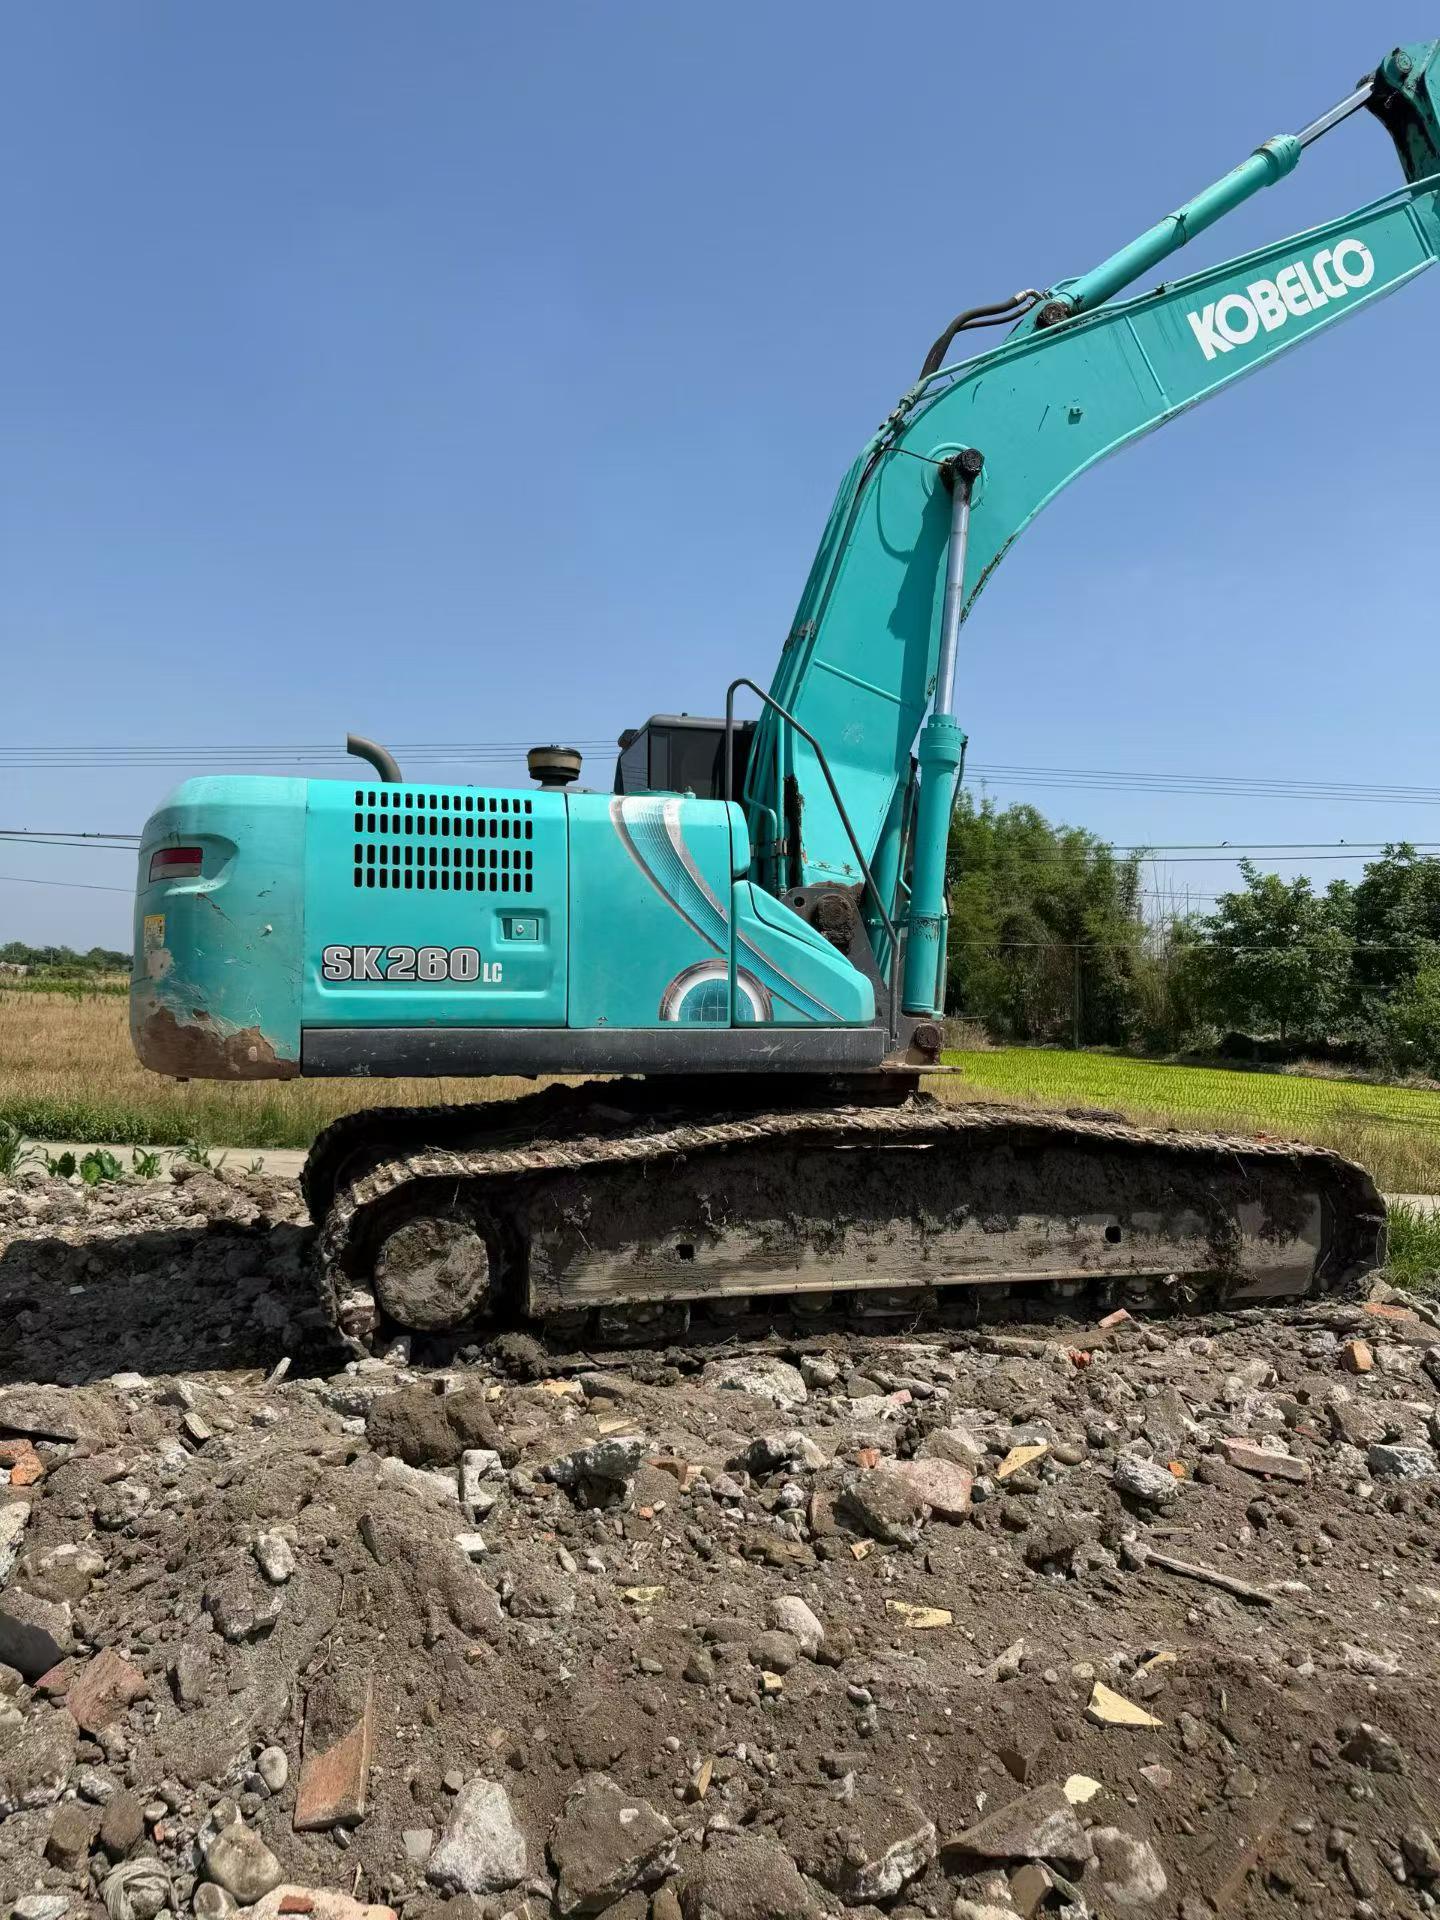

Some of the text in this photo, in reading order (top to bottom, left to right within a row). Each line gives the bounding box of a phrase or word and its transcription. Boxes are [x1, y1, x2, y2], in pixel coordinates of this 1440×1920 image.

[1186, 239, 1375, 361] KOBELCO
[322, 944, 502, 983] SK260 LC
